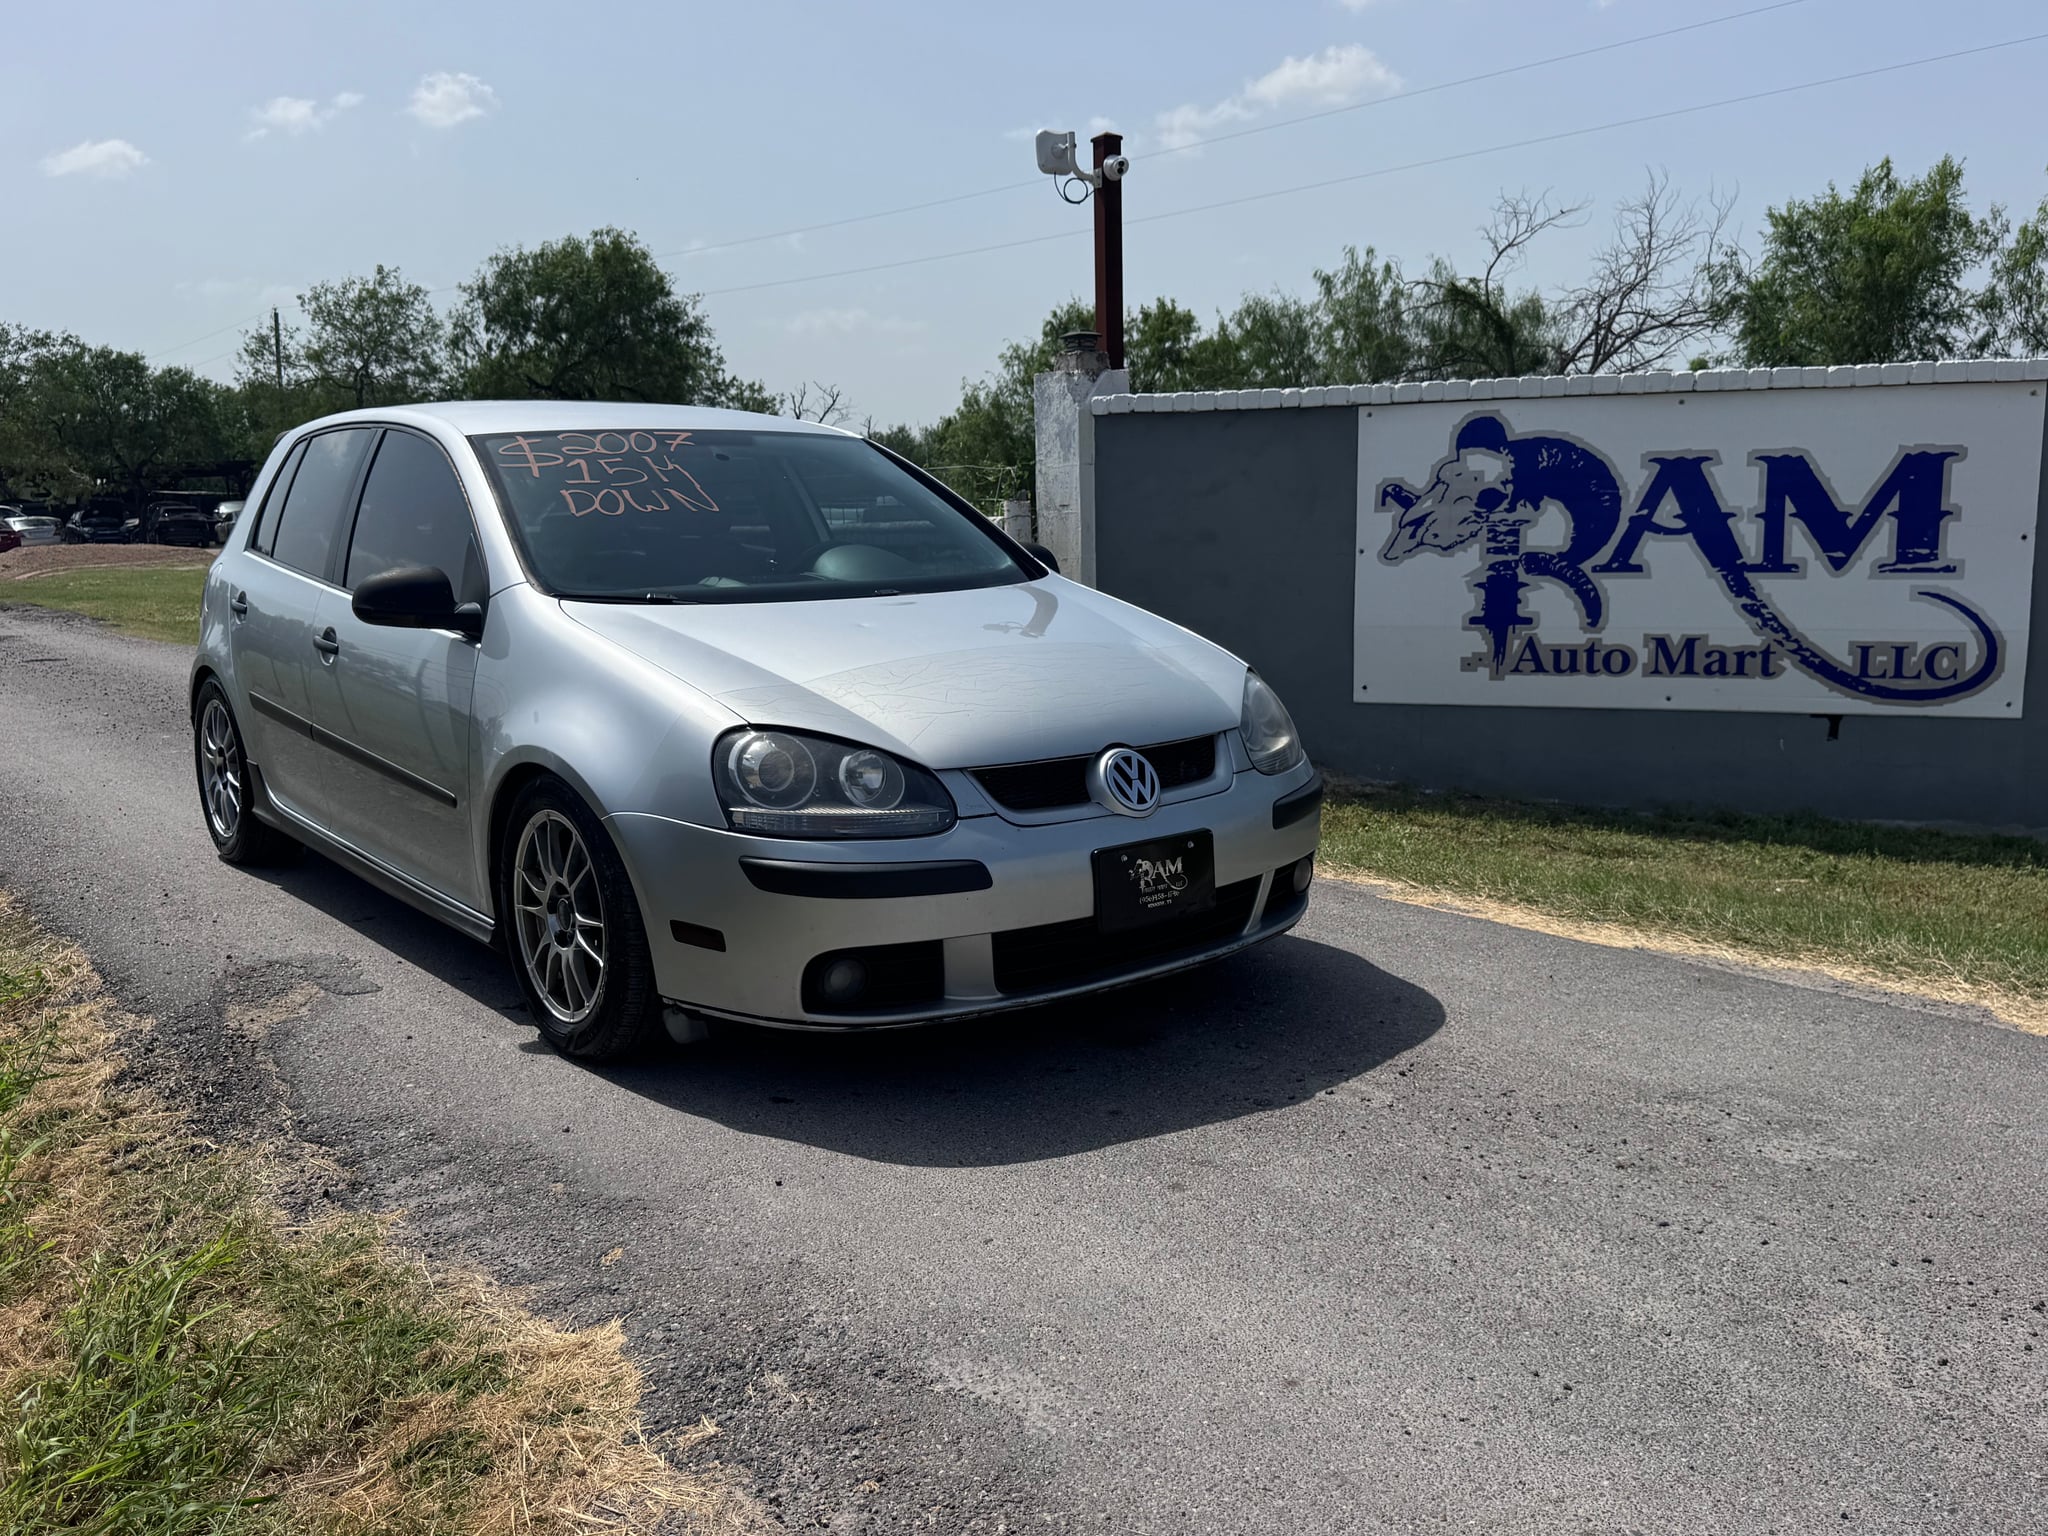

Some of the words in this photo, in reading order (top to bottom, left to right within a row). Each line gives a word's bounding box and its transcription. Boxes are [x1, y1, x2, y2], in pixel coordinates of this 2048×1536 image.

[559, 486, 720, 517] DOWN
[1466, 417, 1962, 635] RAM
[1510, 634, 1632, 675] Auto
[1649, 635, 1778, 678] Mart
[1854, 644, 1961, 682] LLC
[1139, 857, 1184, 887] RAM
